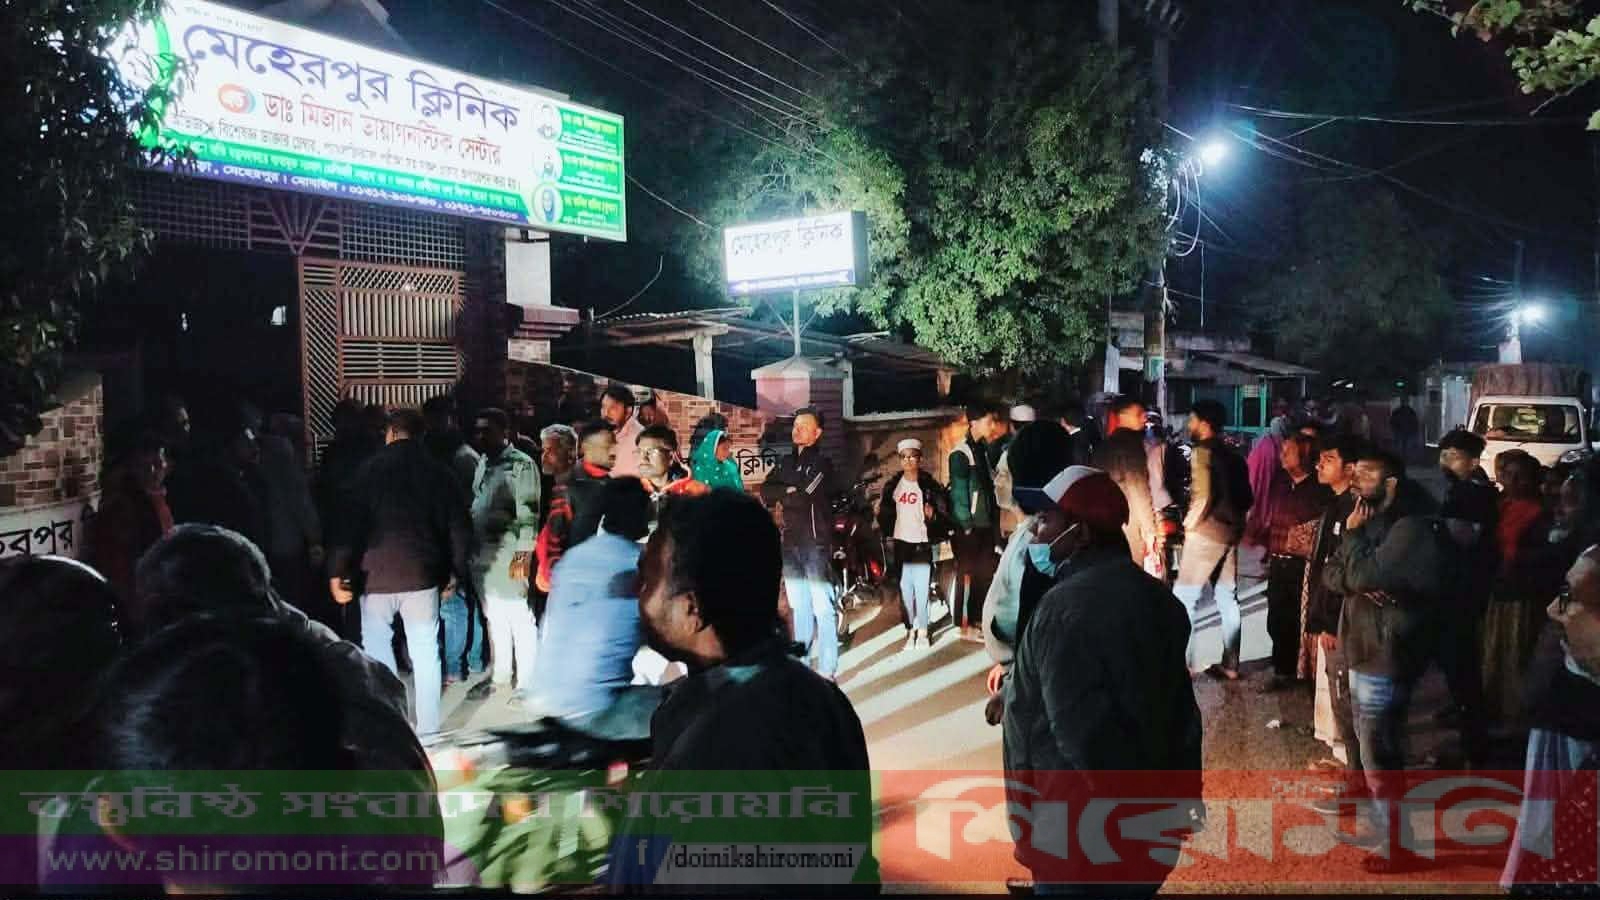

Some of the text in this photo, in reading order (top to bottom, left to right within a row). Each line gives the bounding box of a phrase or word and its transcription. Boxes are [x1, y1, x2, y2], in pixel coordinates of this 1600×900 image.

[184, 24, 520, 132] মেহেরপুর ক্লিনিক
[300, 94, 353, 132] মিজান
[458, 135, 502, 168] সেন্টার
[898, 491, 918, 505] 4G
